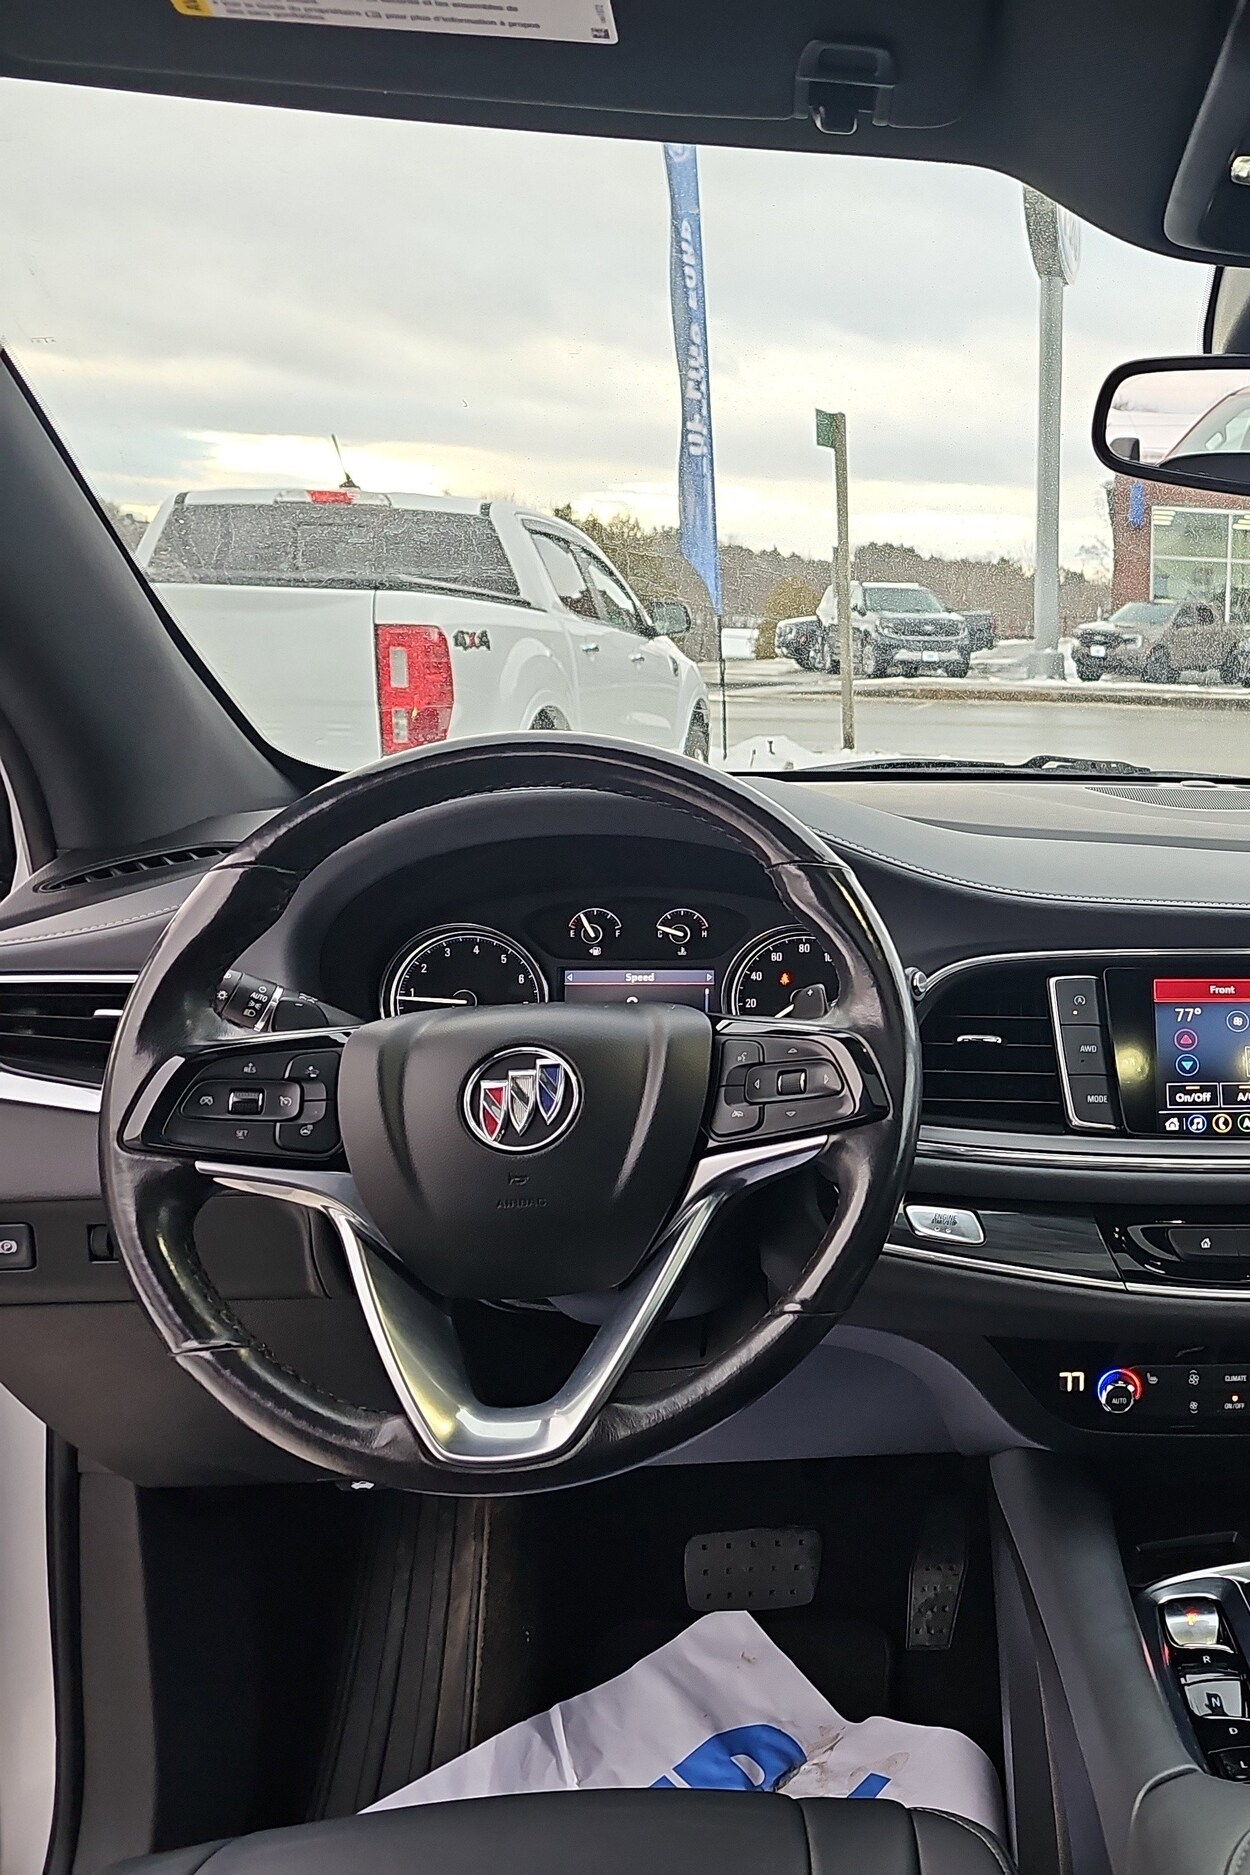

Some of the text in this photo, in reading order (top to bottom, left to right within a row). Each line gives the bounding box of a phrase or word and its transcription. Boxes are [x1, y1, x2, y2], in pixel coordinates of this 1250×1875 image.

[444, 948, 451, 957] 3
[473, 945, 480, 954] 4
[798, 943, 810, 953] 80
[500, 954, 507, 964] 5
[771, 952, 783, 962] 60
[420, 963, 428, 974] 2
[518, 974, 525, 984] 6
[625, 973, 655, 984] Speed
[750, 971, 763, 981] 40
[1209, 985, 1236, 995] Front
[250, 991, 269, 1003] AUTO
[745, 998, 757, 1008] 20
[1080, 1045, 1097, 1053] AWD
[1087, 1095, 1108, 1103] MODE
[1175, 1092, 1211, 1103] On/Off
[1224, 1374, 1248, 1382] CLIMATE
[1111, 1397, 1127, 1405] AUTO
[1202, 1655, 1211, 1664] R
[1211, 1696, 1221, 1708] N
[1228, 1727, 1239, 1735] D
